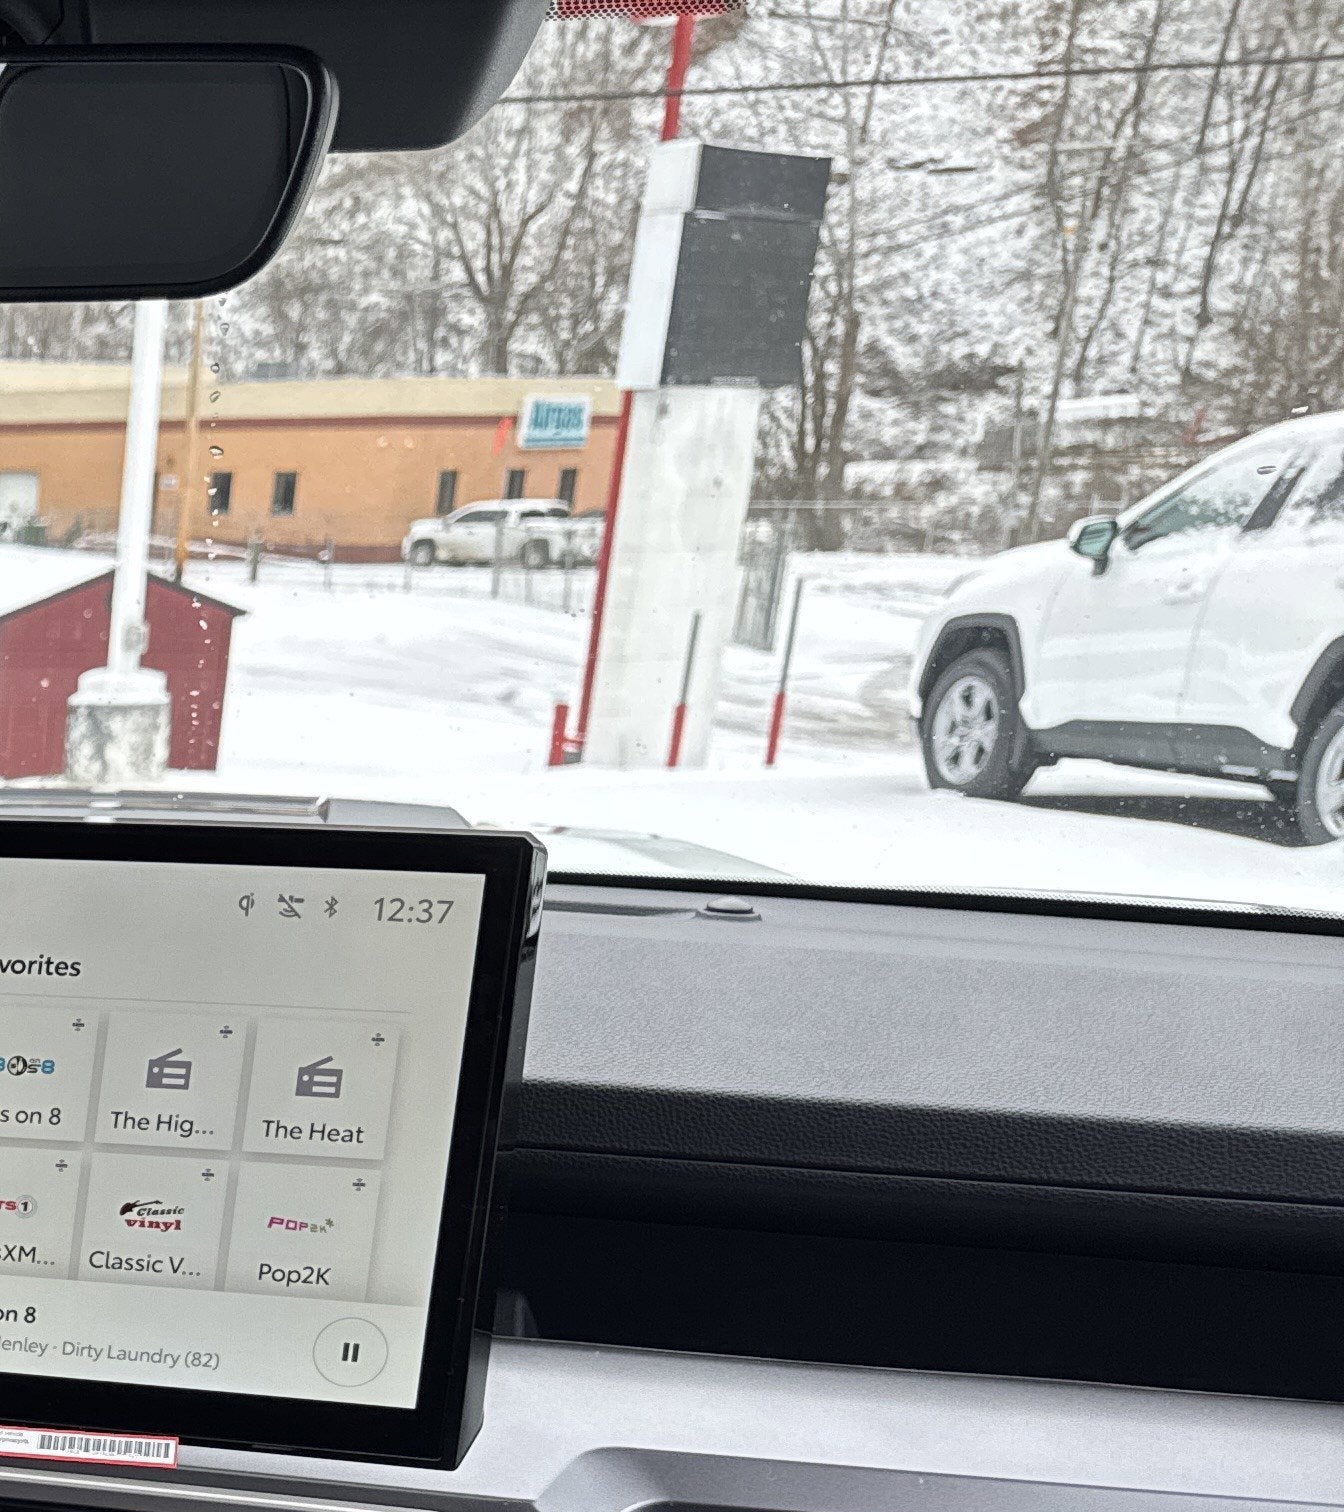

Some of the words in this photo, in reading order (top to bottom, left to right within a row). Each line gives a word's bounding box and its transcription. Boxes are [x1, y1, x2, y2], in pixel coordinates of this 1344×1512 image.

[372, 896, 454, 925] 12:37
[14, 1108, 42, 1125] on
[48, 1106, 62, 1126] 8
[111, 1110, 149, 1133] The
[155, 1113, 214, 1139] Hig...
[262, 1119, 302, 1142] The
[309, 1122, 364, 1144] Heat
[137, 1206, 185, 1217] Classic
[125, 1217, 181, 1232] vinyl
[88, 1250, 164, 1275] Classic
[258, 1263, 331, 1287] Pop2K
[23, 1305, 37, 1325] 8
[62, 1339, 103, 1363] Dirty
[107, 1344, 181, 1369] Laundry
[185, 1349, 220, 1371] (82)
